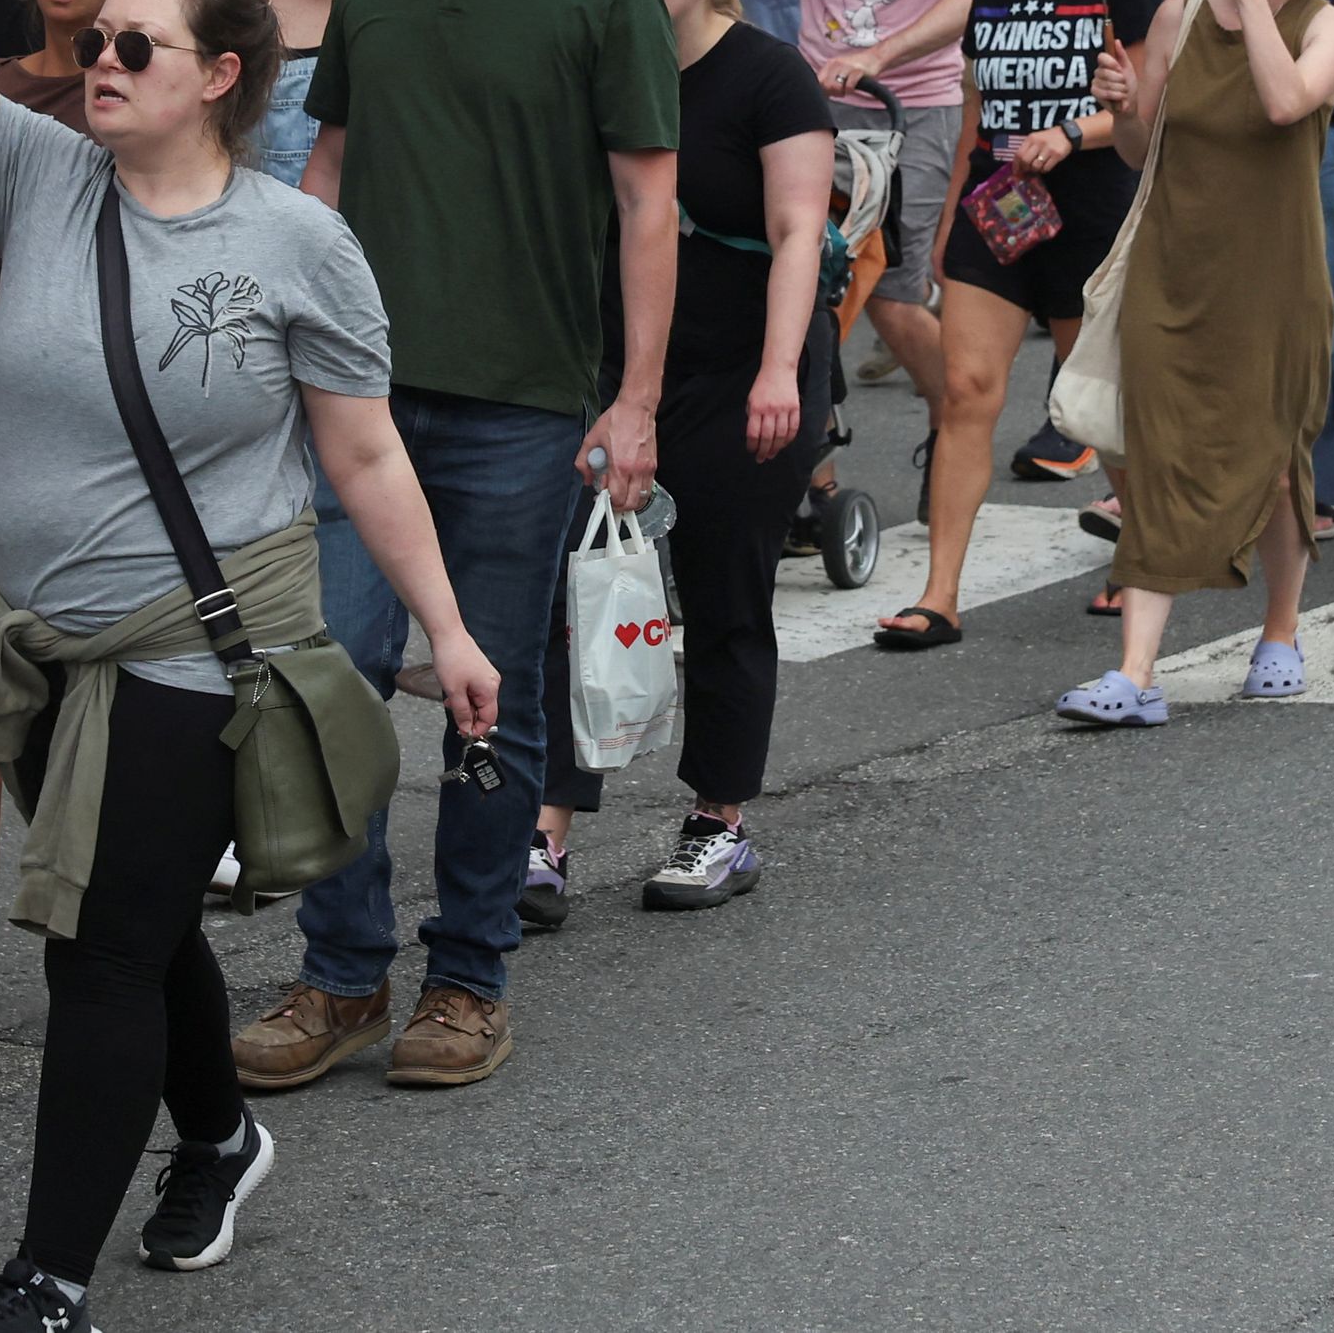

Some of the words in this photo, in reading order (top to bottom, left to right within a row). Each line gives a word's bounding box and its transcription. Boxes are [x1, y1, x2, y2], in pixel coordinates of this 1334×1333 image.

[990, 20, 1072, 51] KINGS
[1074, 18, 1103, 50] IN
[973, 56, 1088, 91] MERICA
[1028, 96, 1097, 130] 1776
